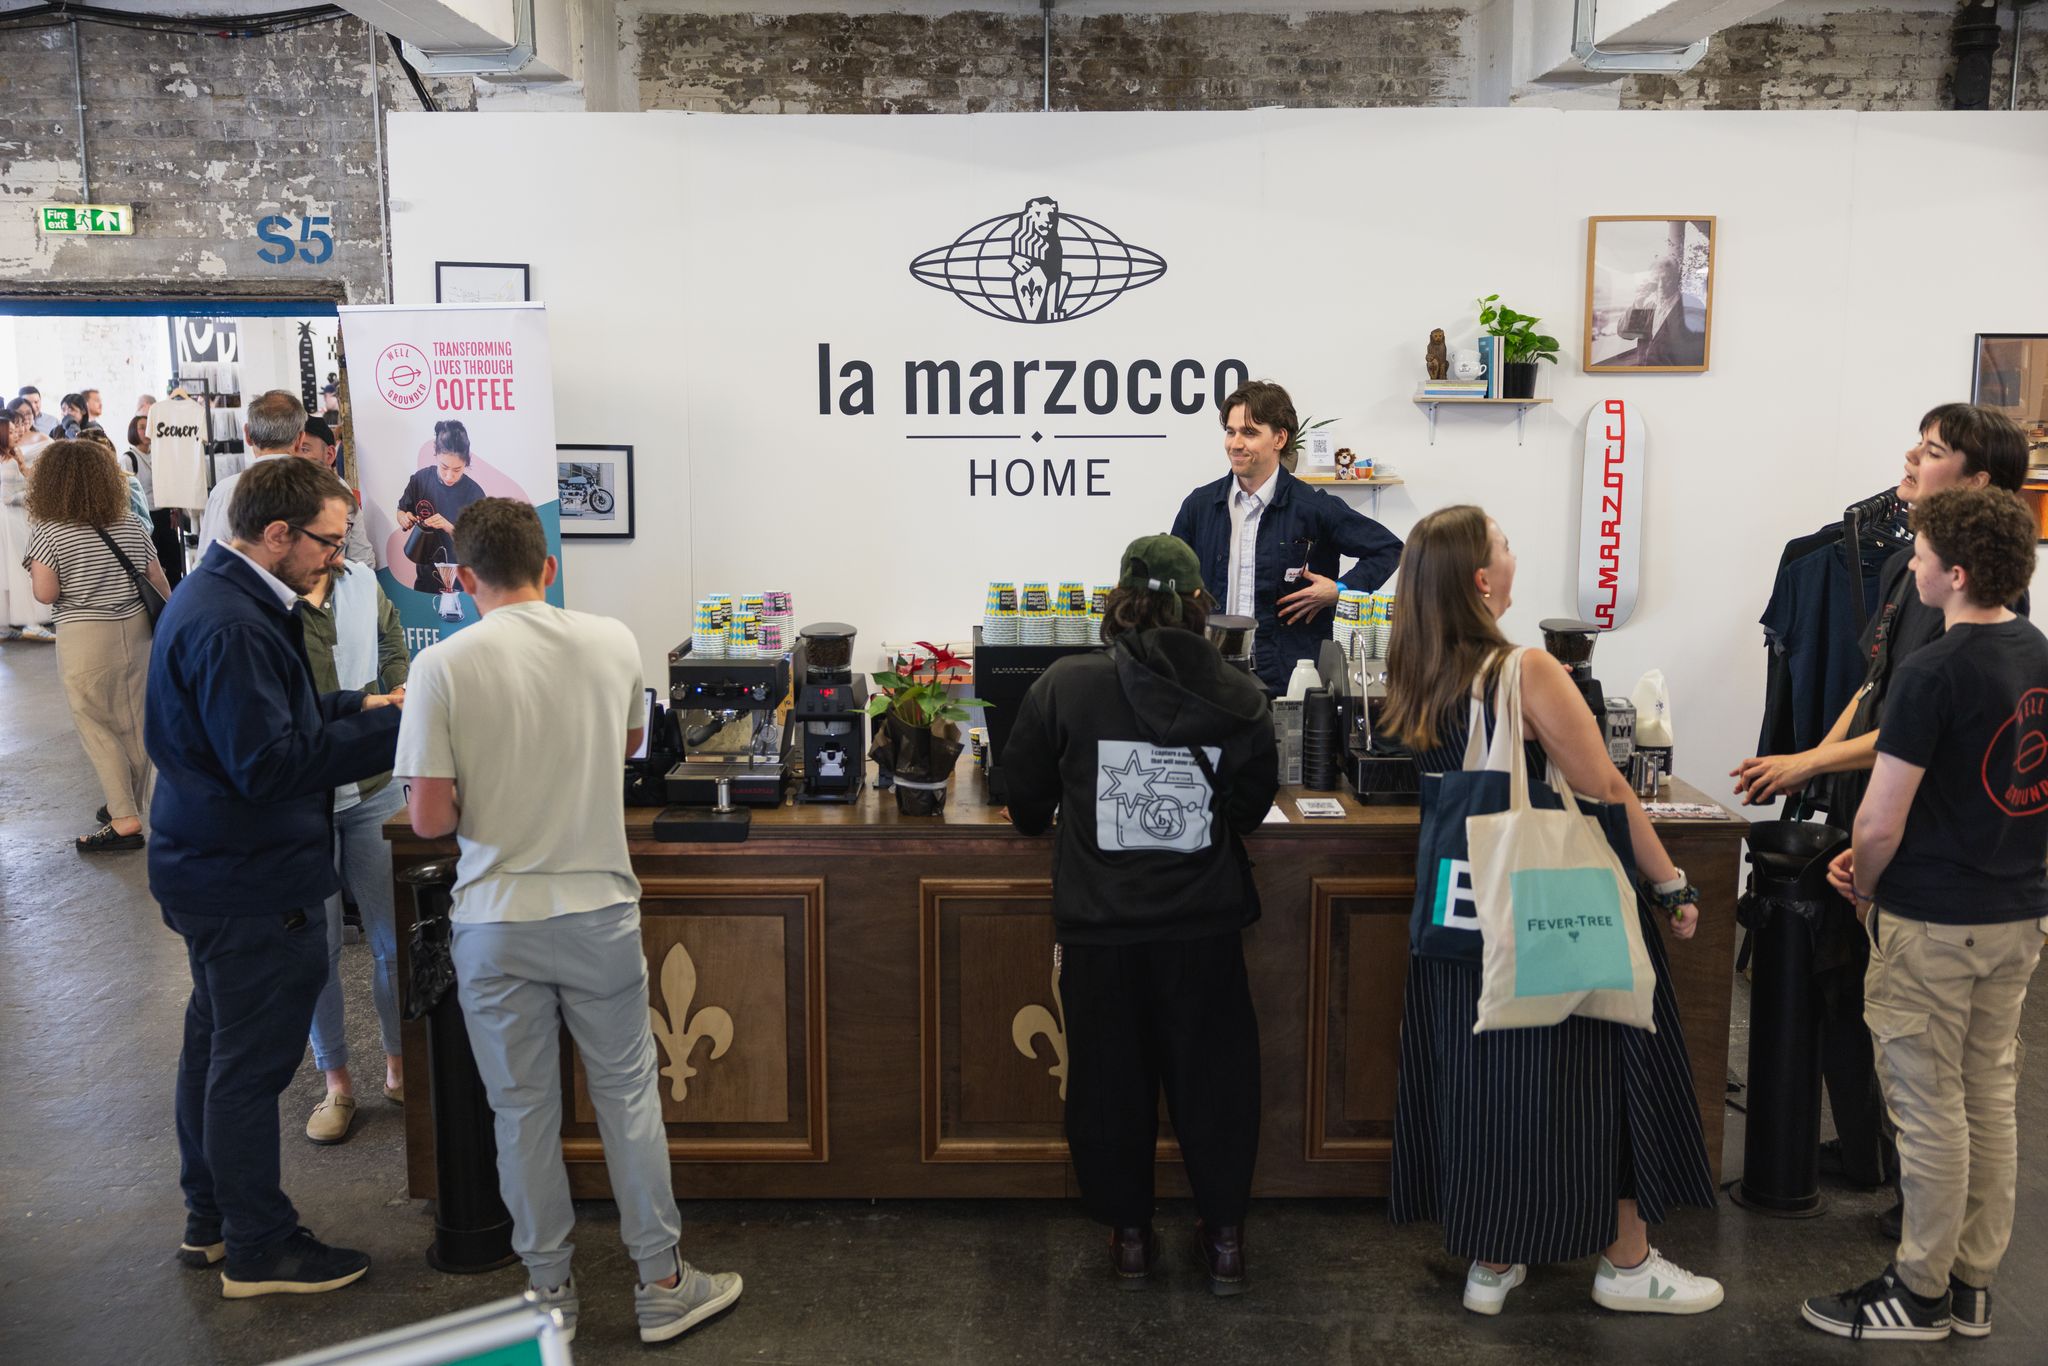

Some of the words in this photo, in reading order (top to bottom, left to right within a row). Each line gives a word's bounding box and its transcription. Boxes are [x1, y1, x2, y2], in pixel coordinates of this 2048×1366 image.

[47, 210, 68, 220] Fire
[48, 221, 68, 229] exit
[256, 215, 334, 264] S5
[386, 348, 410, 361] WELL
[433, 341, 512, 356] TRANSFORMING
[434, 360, 461, 375] LIVES
[464, 360, 513, 375] THROUGH
[818, 343, 874, 416] la
[905, 359, 1250, 416] marzocco
[387, 383, 427, 405] GROUNDED
[435, 378, 515, 410] COFFEE
[969, 458, 1111, 497] HOME
[1612, 725, 1632, 738] LY!
[1155, 750, 1177, 758] capture
[1527, 914, 1613, 932] FEVER-TREE
